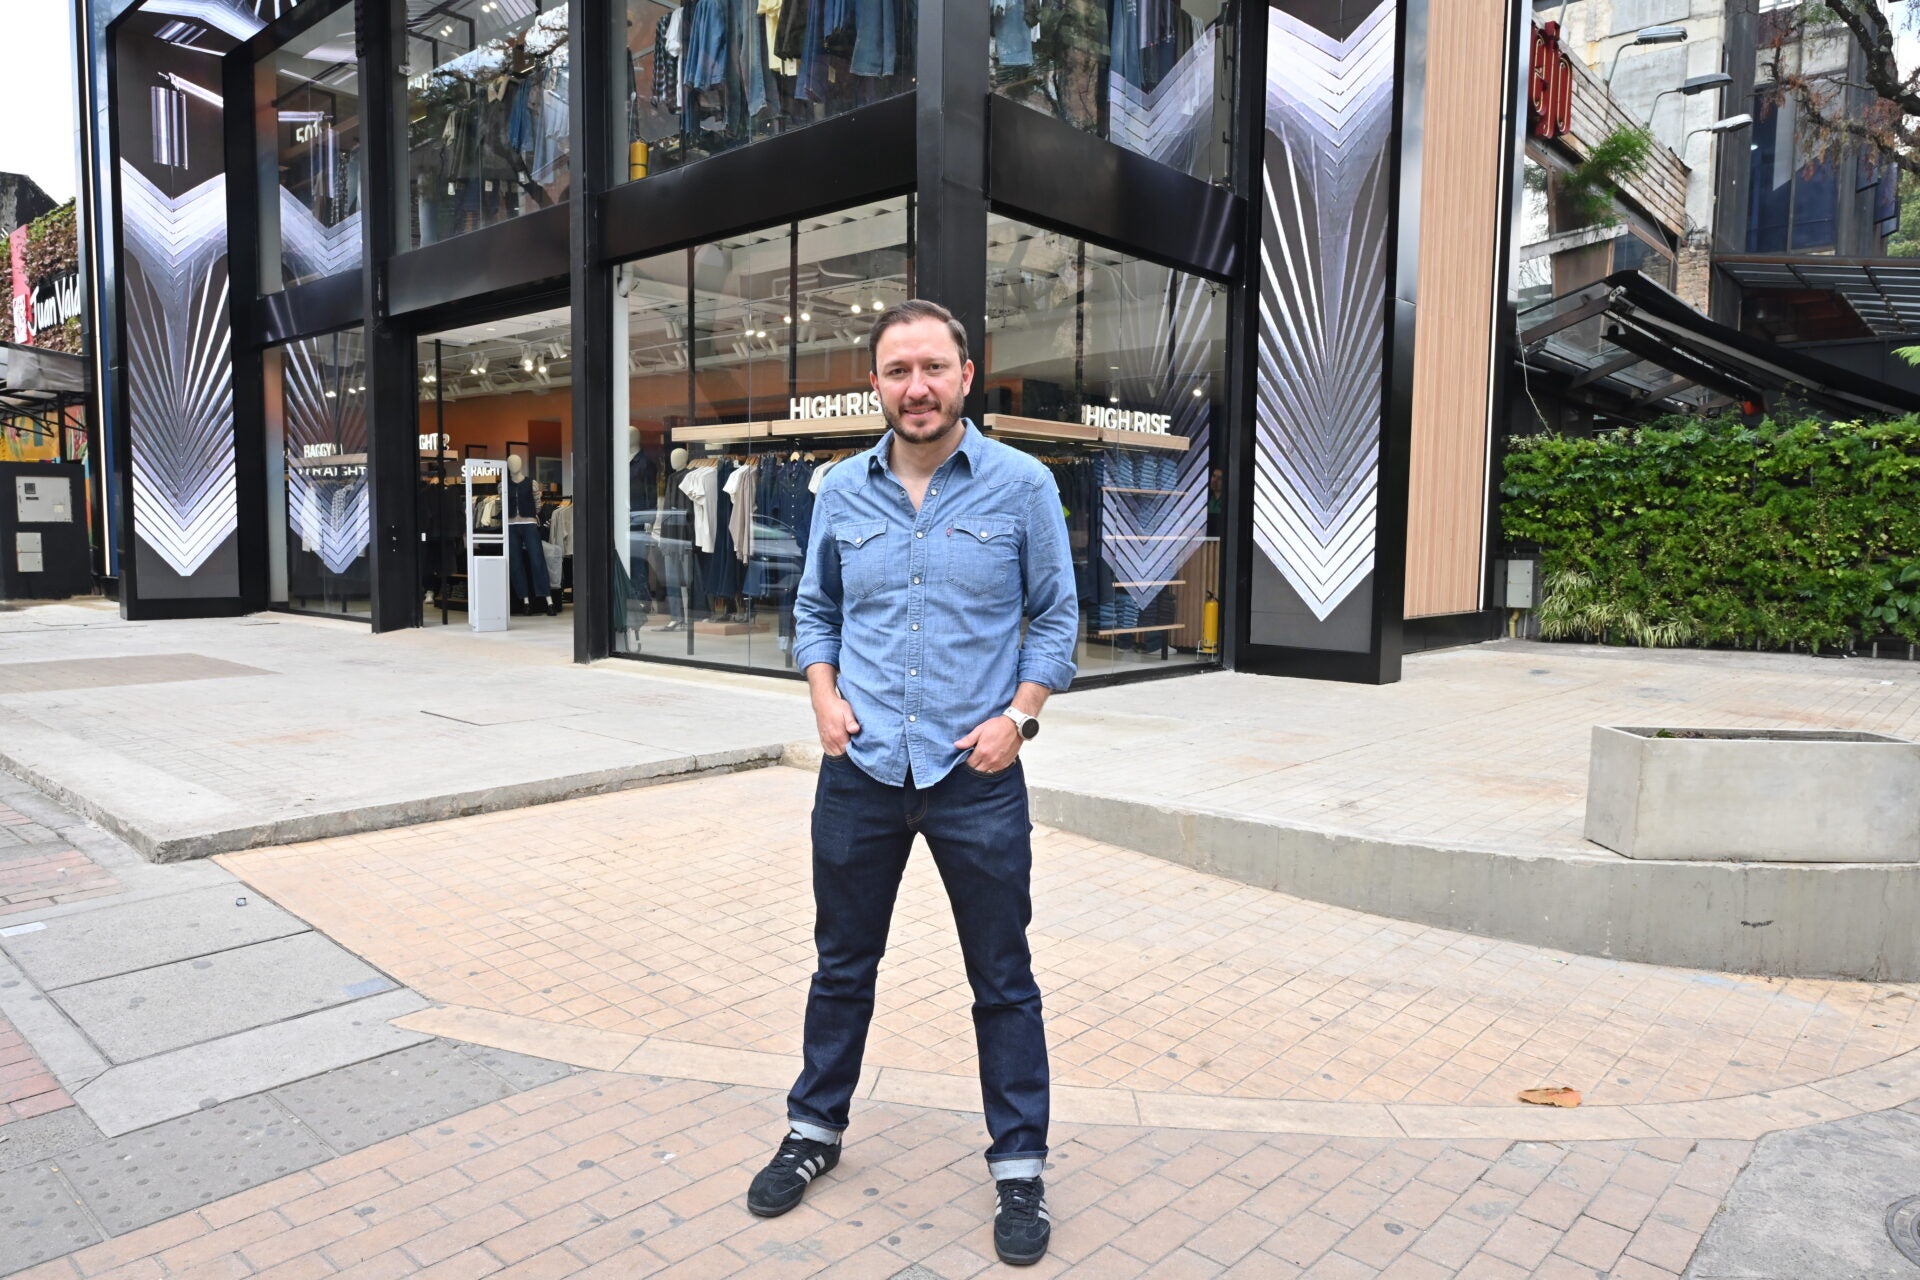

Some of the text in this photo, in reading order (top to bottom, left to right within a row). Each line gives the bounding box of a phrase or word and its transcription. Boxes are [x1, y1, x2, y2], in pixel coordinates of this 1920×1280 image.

[27, 285, 57, 337] Juan
[790, 390, 883, 420] HIGH RIS
[1085, 404, 1172, 436] HIGH RISE
[303, 443, 332, 458] BAGGY
[461, 465, 500, 477] SRAIGHT
